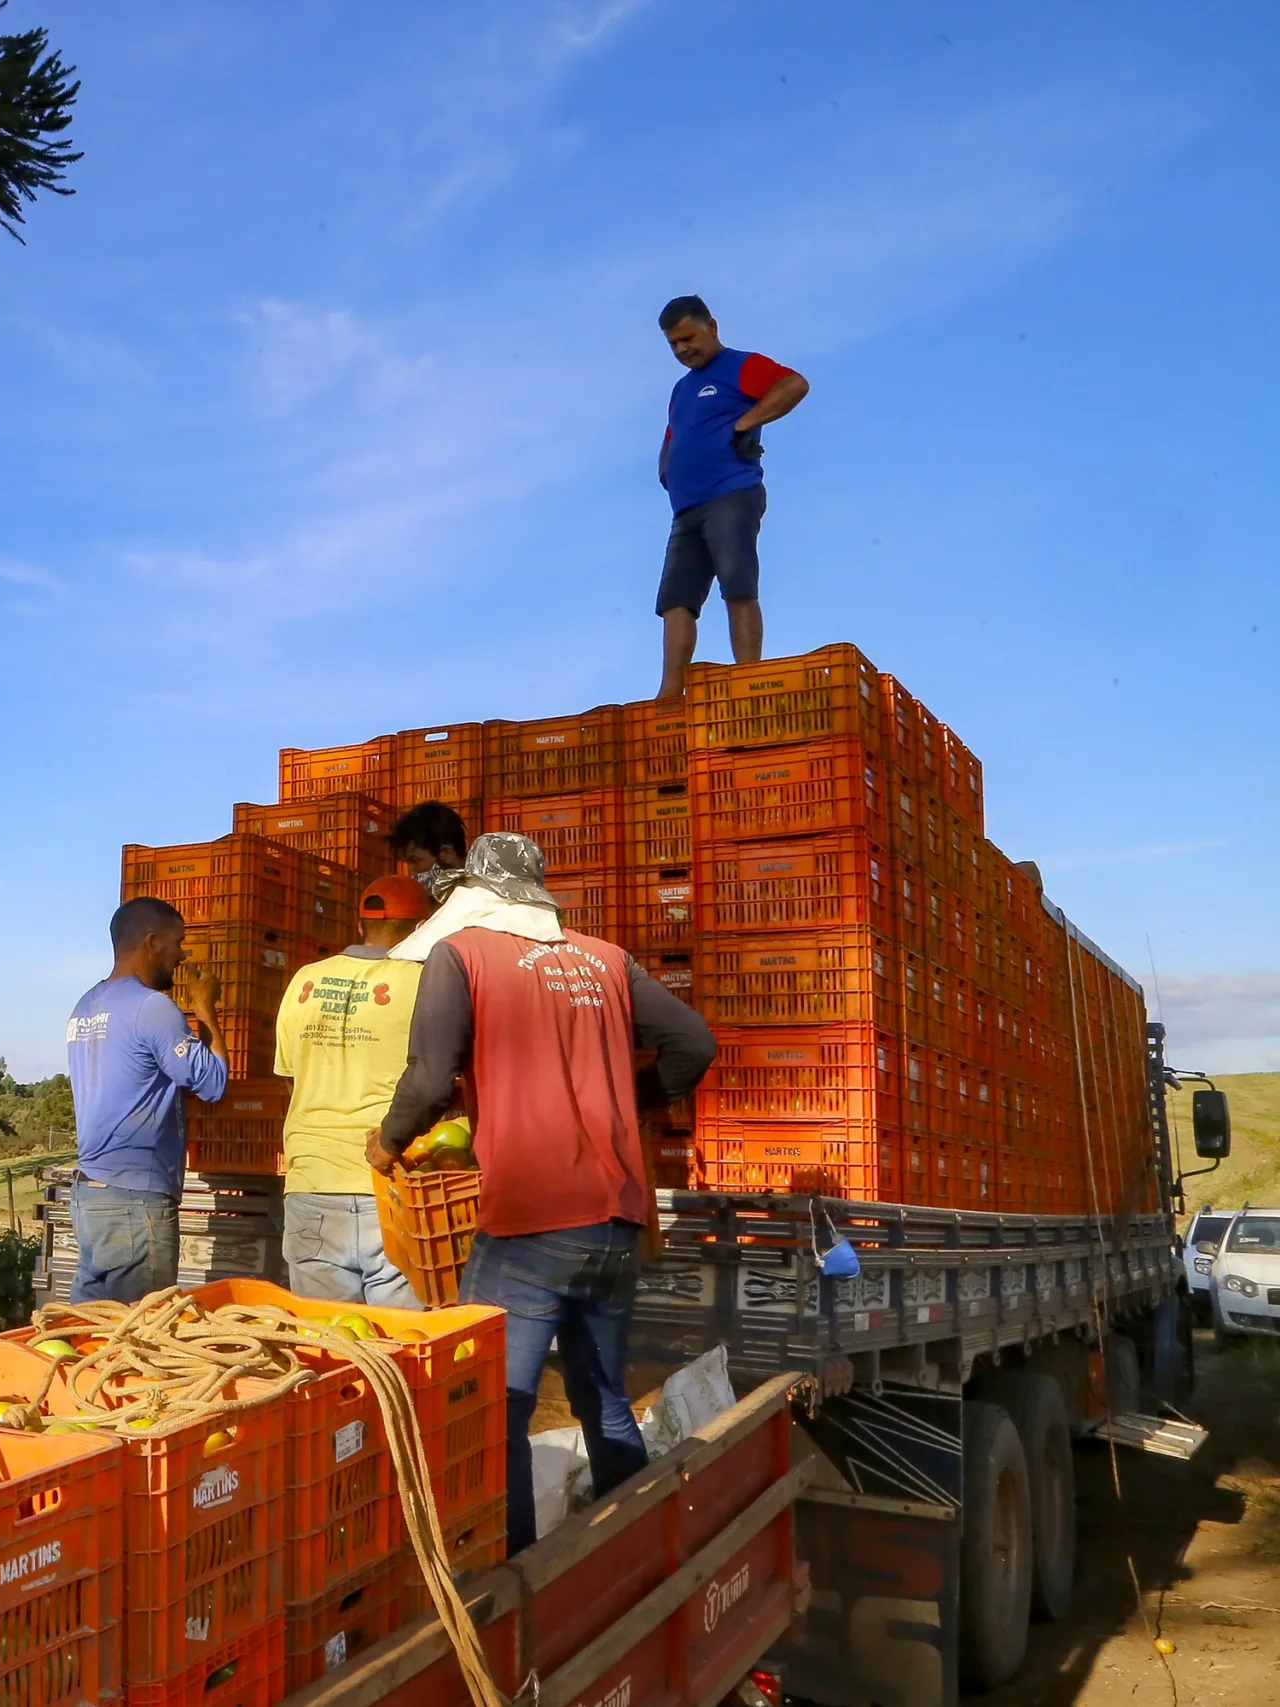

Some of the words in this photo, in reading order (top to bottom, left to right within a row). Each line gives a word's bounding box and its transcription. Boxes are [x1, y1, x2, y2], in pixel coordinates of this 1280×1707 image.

[749, 680, 785, 691] MARTINS
[535, 735, 566, 745] MARTINS
[277, 819, 305, 829] MARTINS
[168, 864, 196, 874] MARTINS
[658, 886, 690, 897] MARTINS
[760, 956, 797, 966] MARTINS
[660, 972, 693, 982] MARTINS
[764, 1147, 802, 1157] MARTINS
[193, 1469, 239, 1507] MARTINS
[0, 1540, 62, 1586] MARTINS
